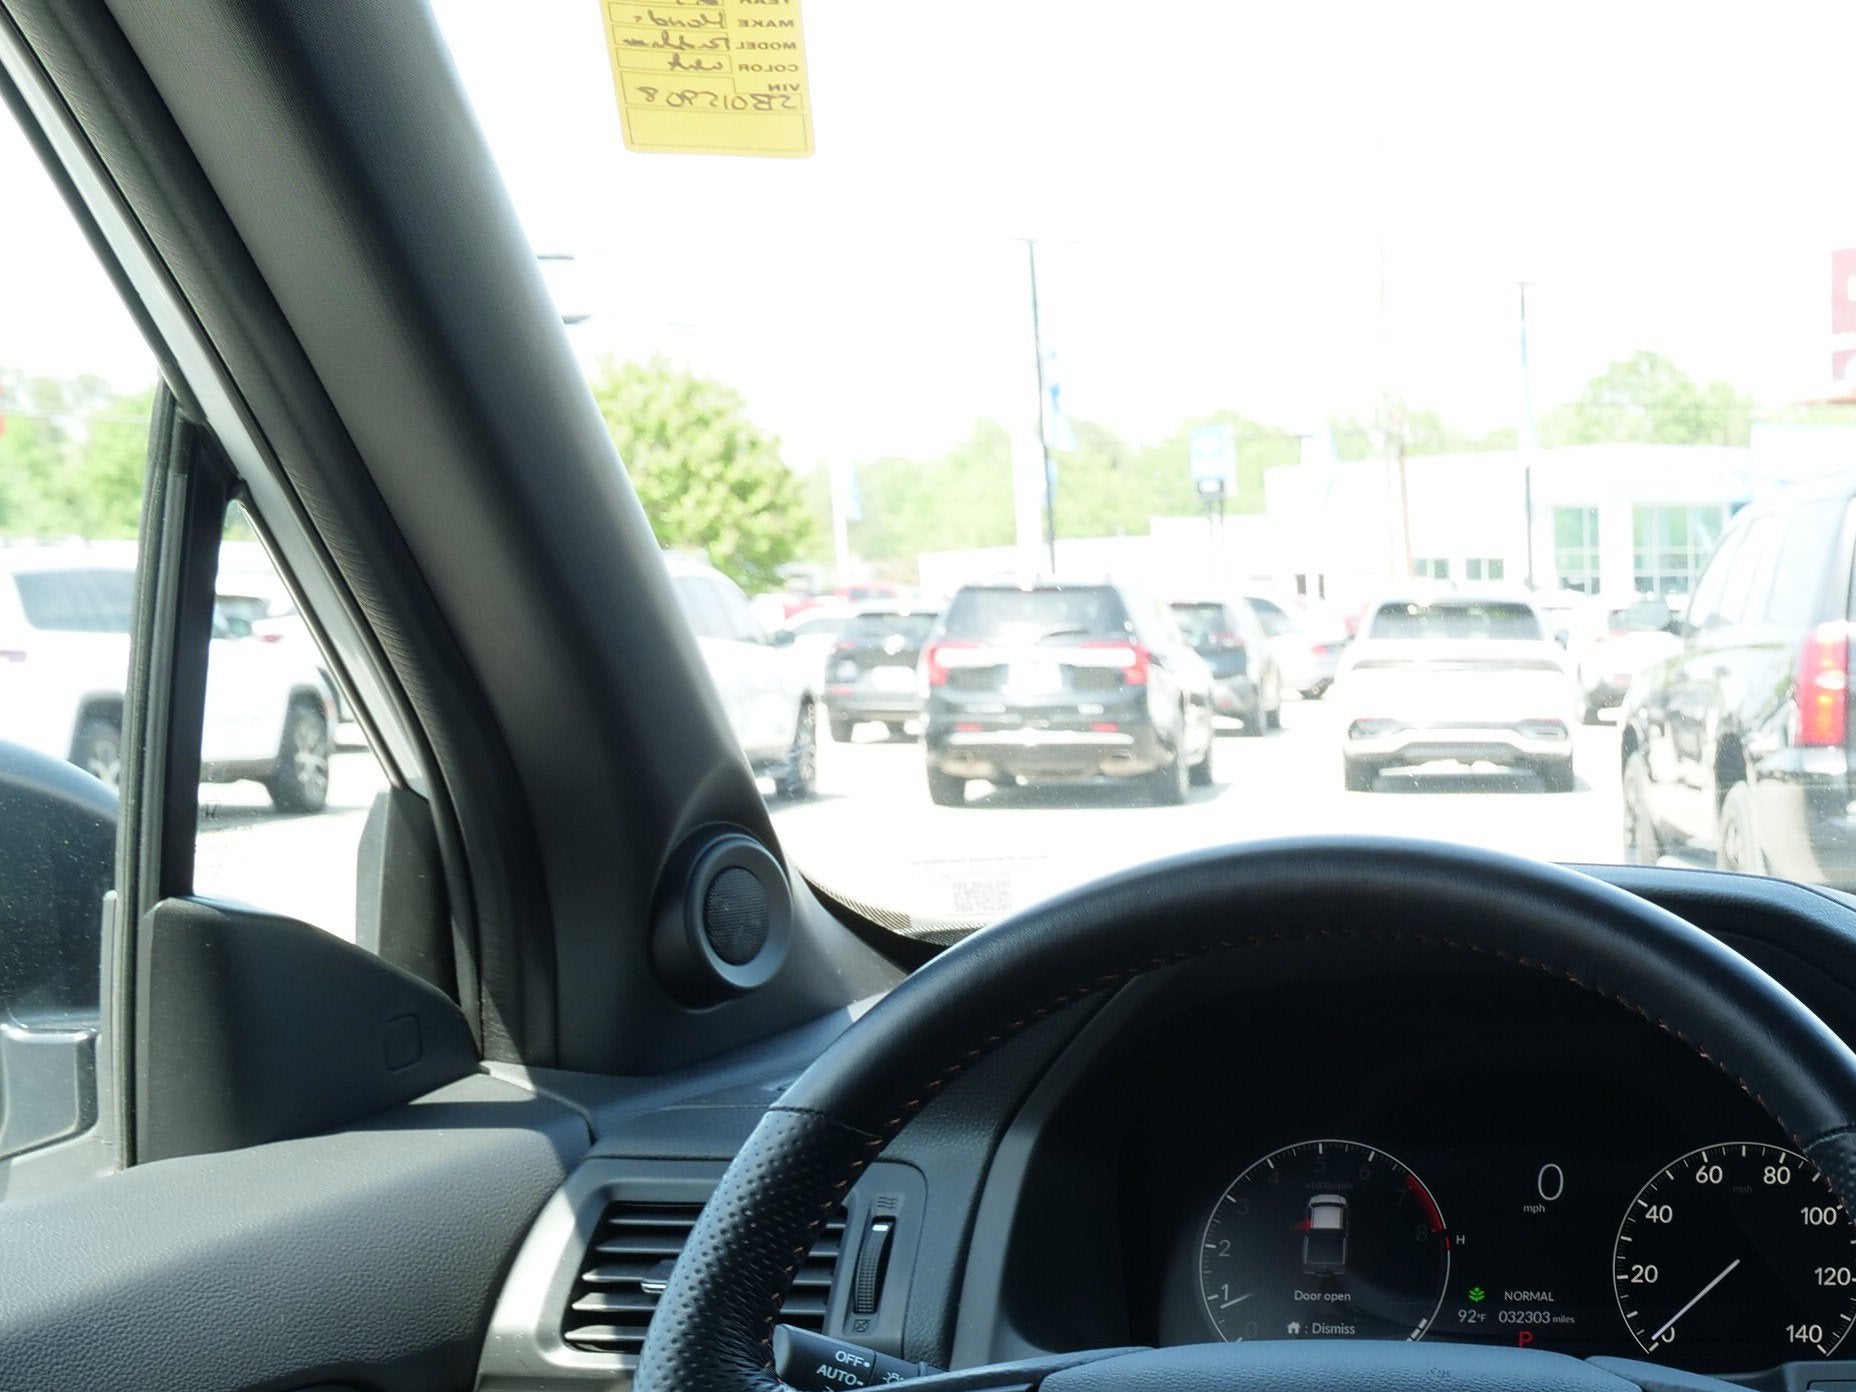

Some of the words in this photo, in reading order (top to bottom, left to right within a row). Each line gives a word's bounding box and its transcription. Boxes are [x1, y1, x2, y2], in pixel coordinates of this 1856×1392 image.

[1538, 1163, 1564, 1201] 0
[1695, 1165, 1723, 1184] 60
[1763, 1166, 1791, 1185] 80
[1523, 1203, 1546, 1214] mph
[1645, 1205, 1673, 1224] 40
[1800, 1206, 1837, 1226] 100
[1218, 1240, 1231, 1258] 2
[1456, 1235, 1466, 1245] H
[1631, 1264, 1659, 1284] 20
[1814, 1267, 1851, 1286] 120
[1220, 1283, 1230, 1301] 1
[1294, 1290, 1322, 1301] Door
[1324, 1292, 1351, 1305] open
[1504, 1290, 1554, 1302] NORMAL
[1498, 1310, 1550, 1324] 032303
[1552, 1315, 1576, 1324] miles
[1312, 1323, 1356, 1335] Dismiss
[1786, 1324, 1823, 1344] 140
[1517, 1331, 1534, 1348] P
[835, 1351, 864, 1367] OFF
[816, 1364, 858, 1386] AUTO
